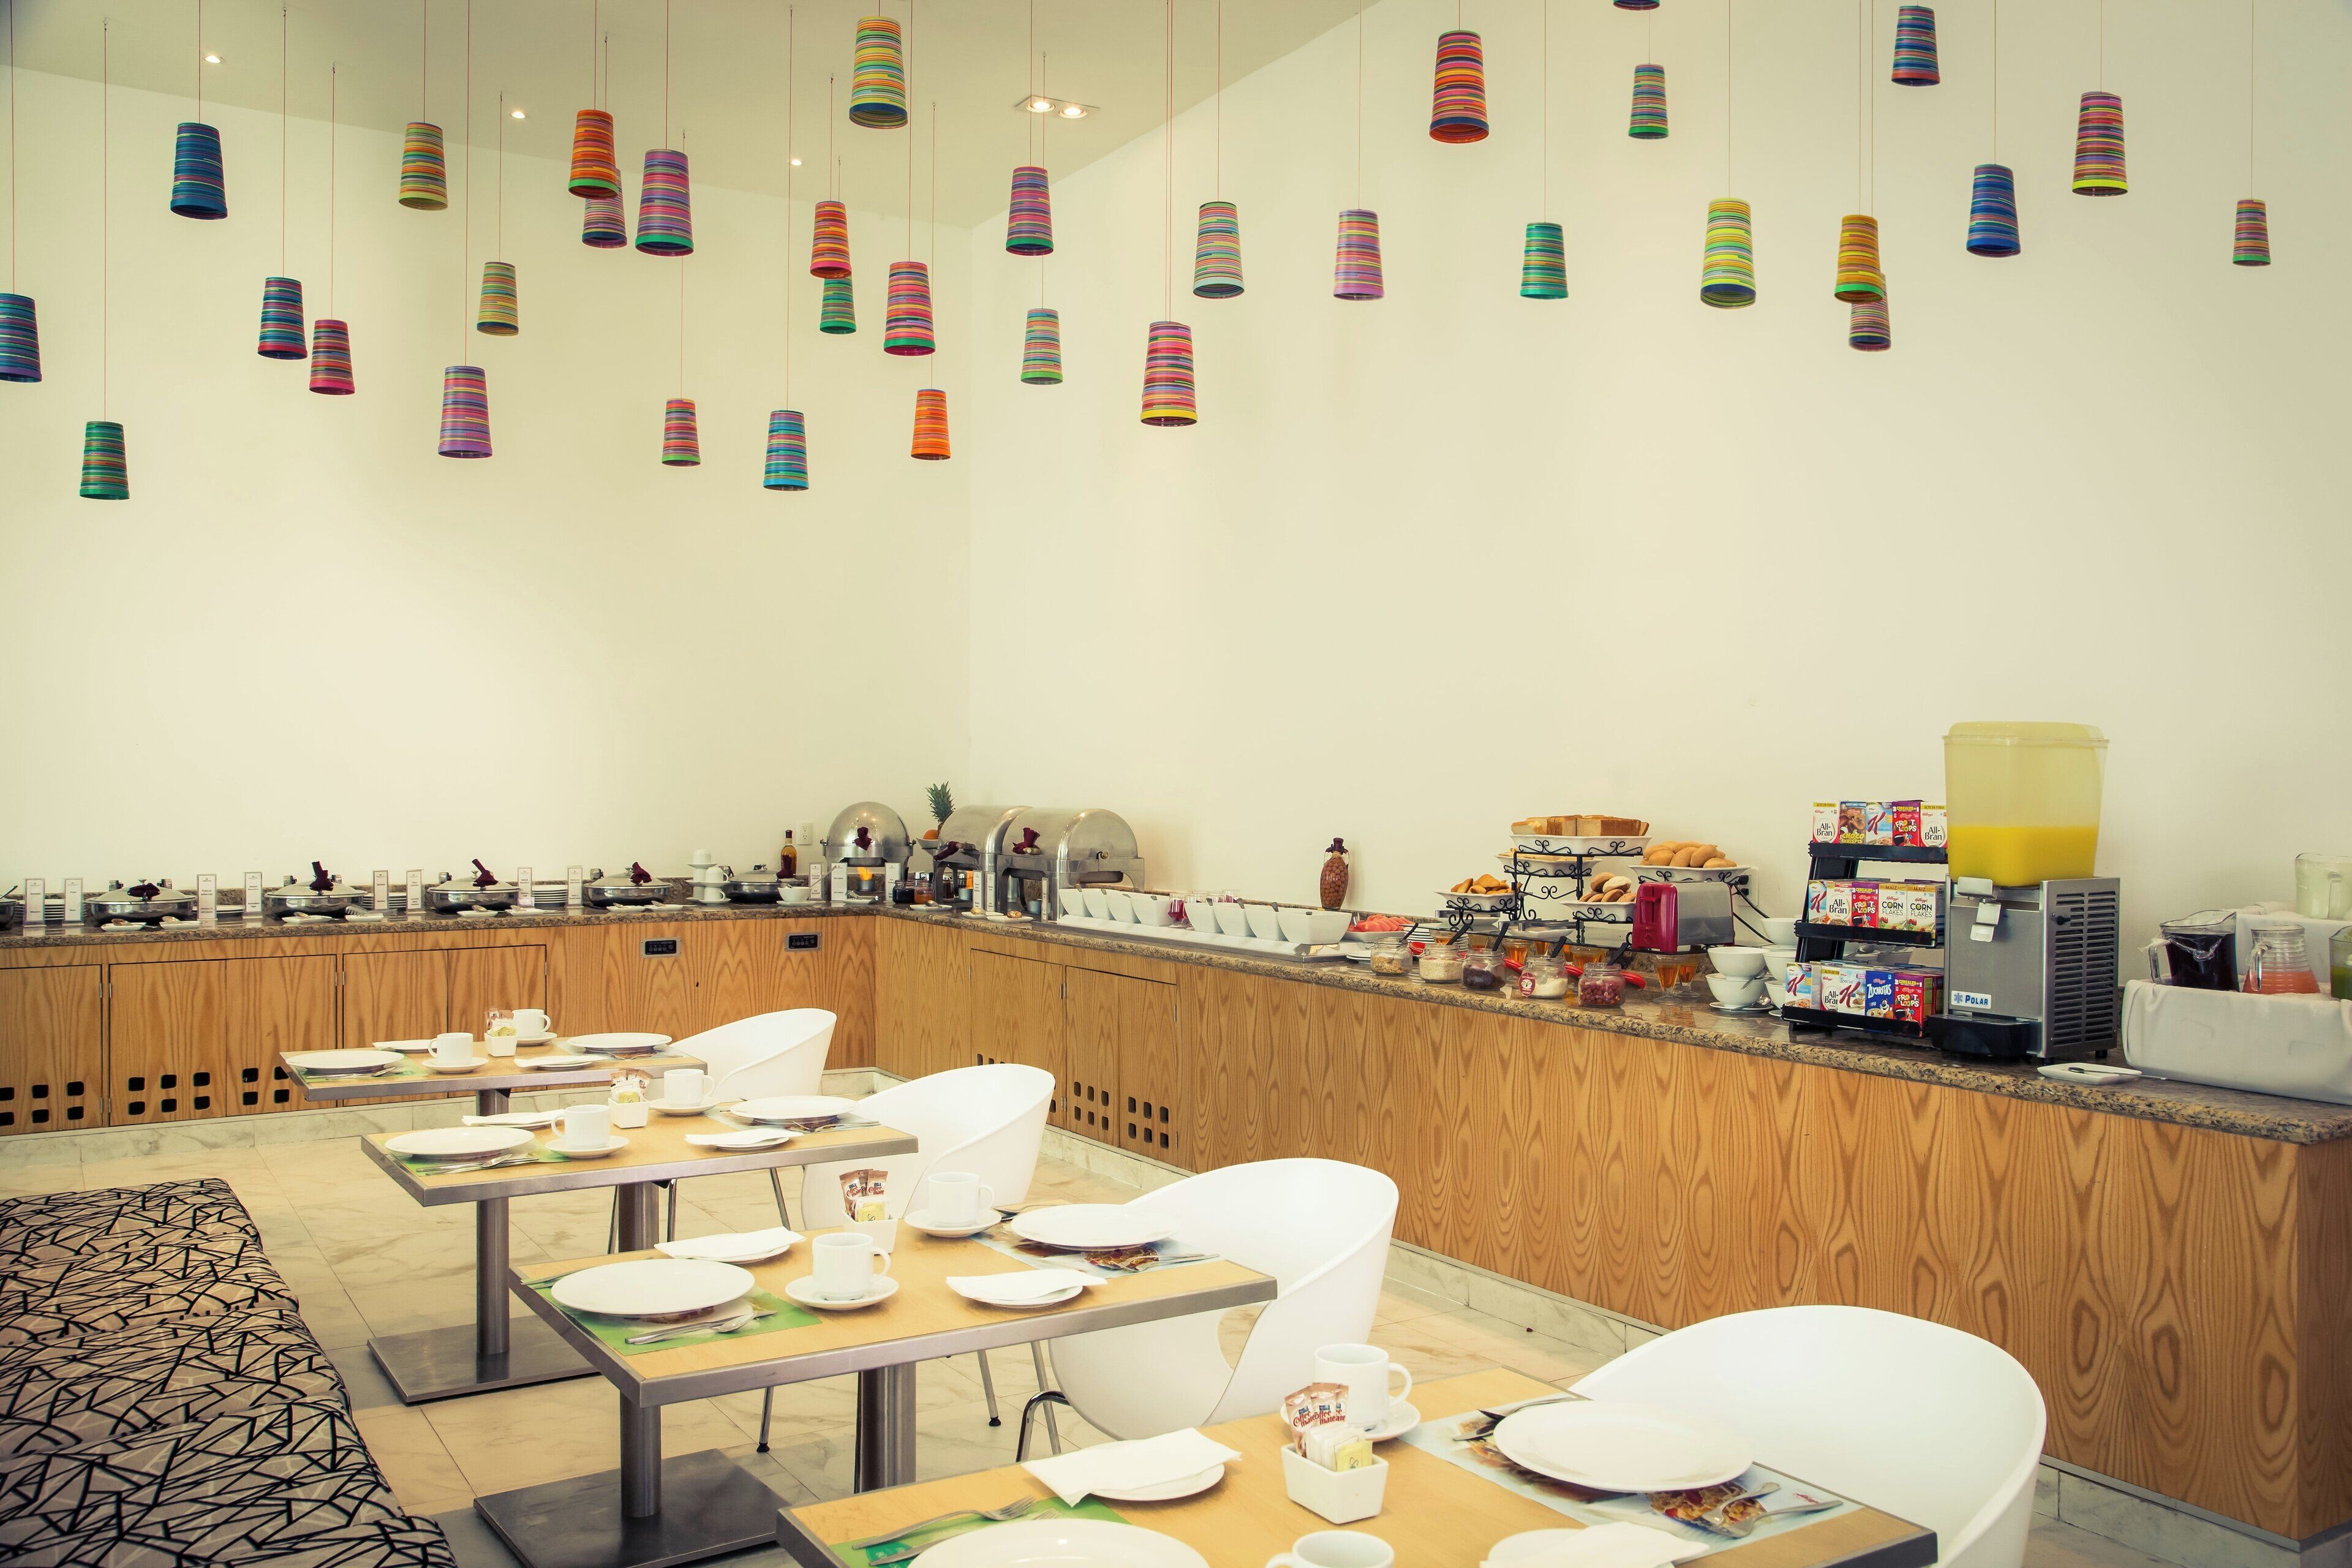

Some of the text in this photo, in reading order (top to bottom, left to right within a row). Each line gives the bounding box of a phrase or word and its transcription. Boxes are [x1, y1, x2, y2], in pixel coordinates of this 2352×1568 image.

[1868, 812, 1886, 835] K
[1810, 890, 1827, 913] K
[1829, 904, 1847, 914] Bran
[1833, 899, 1846, 907] All-
[1910, 903, 1932, 911] CORN
[1787, 973, 1806, 997] K
[1867, 984, 1892, 999] ZUCARITAS
[1839, 981, 1861, 1008] K
[1965, 995, 1988, 1005] POLAR
